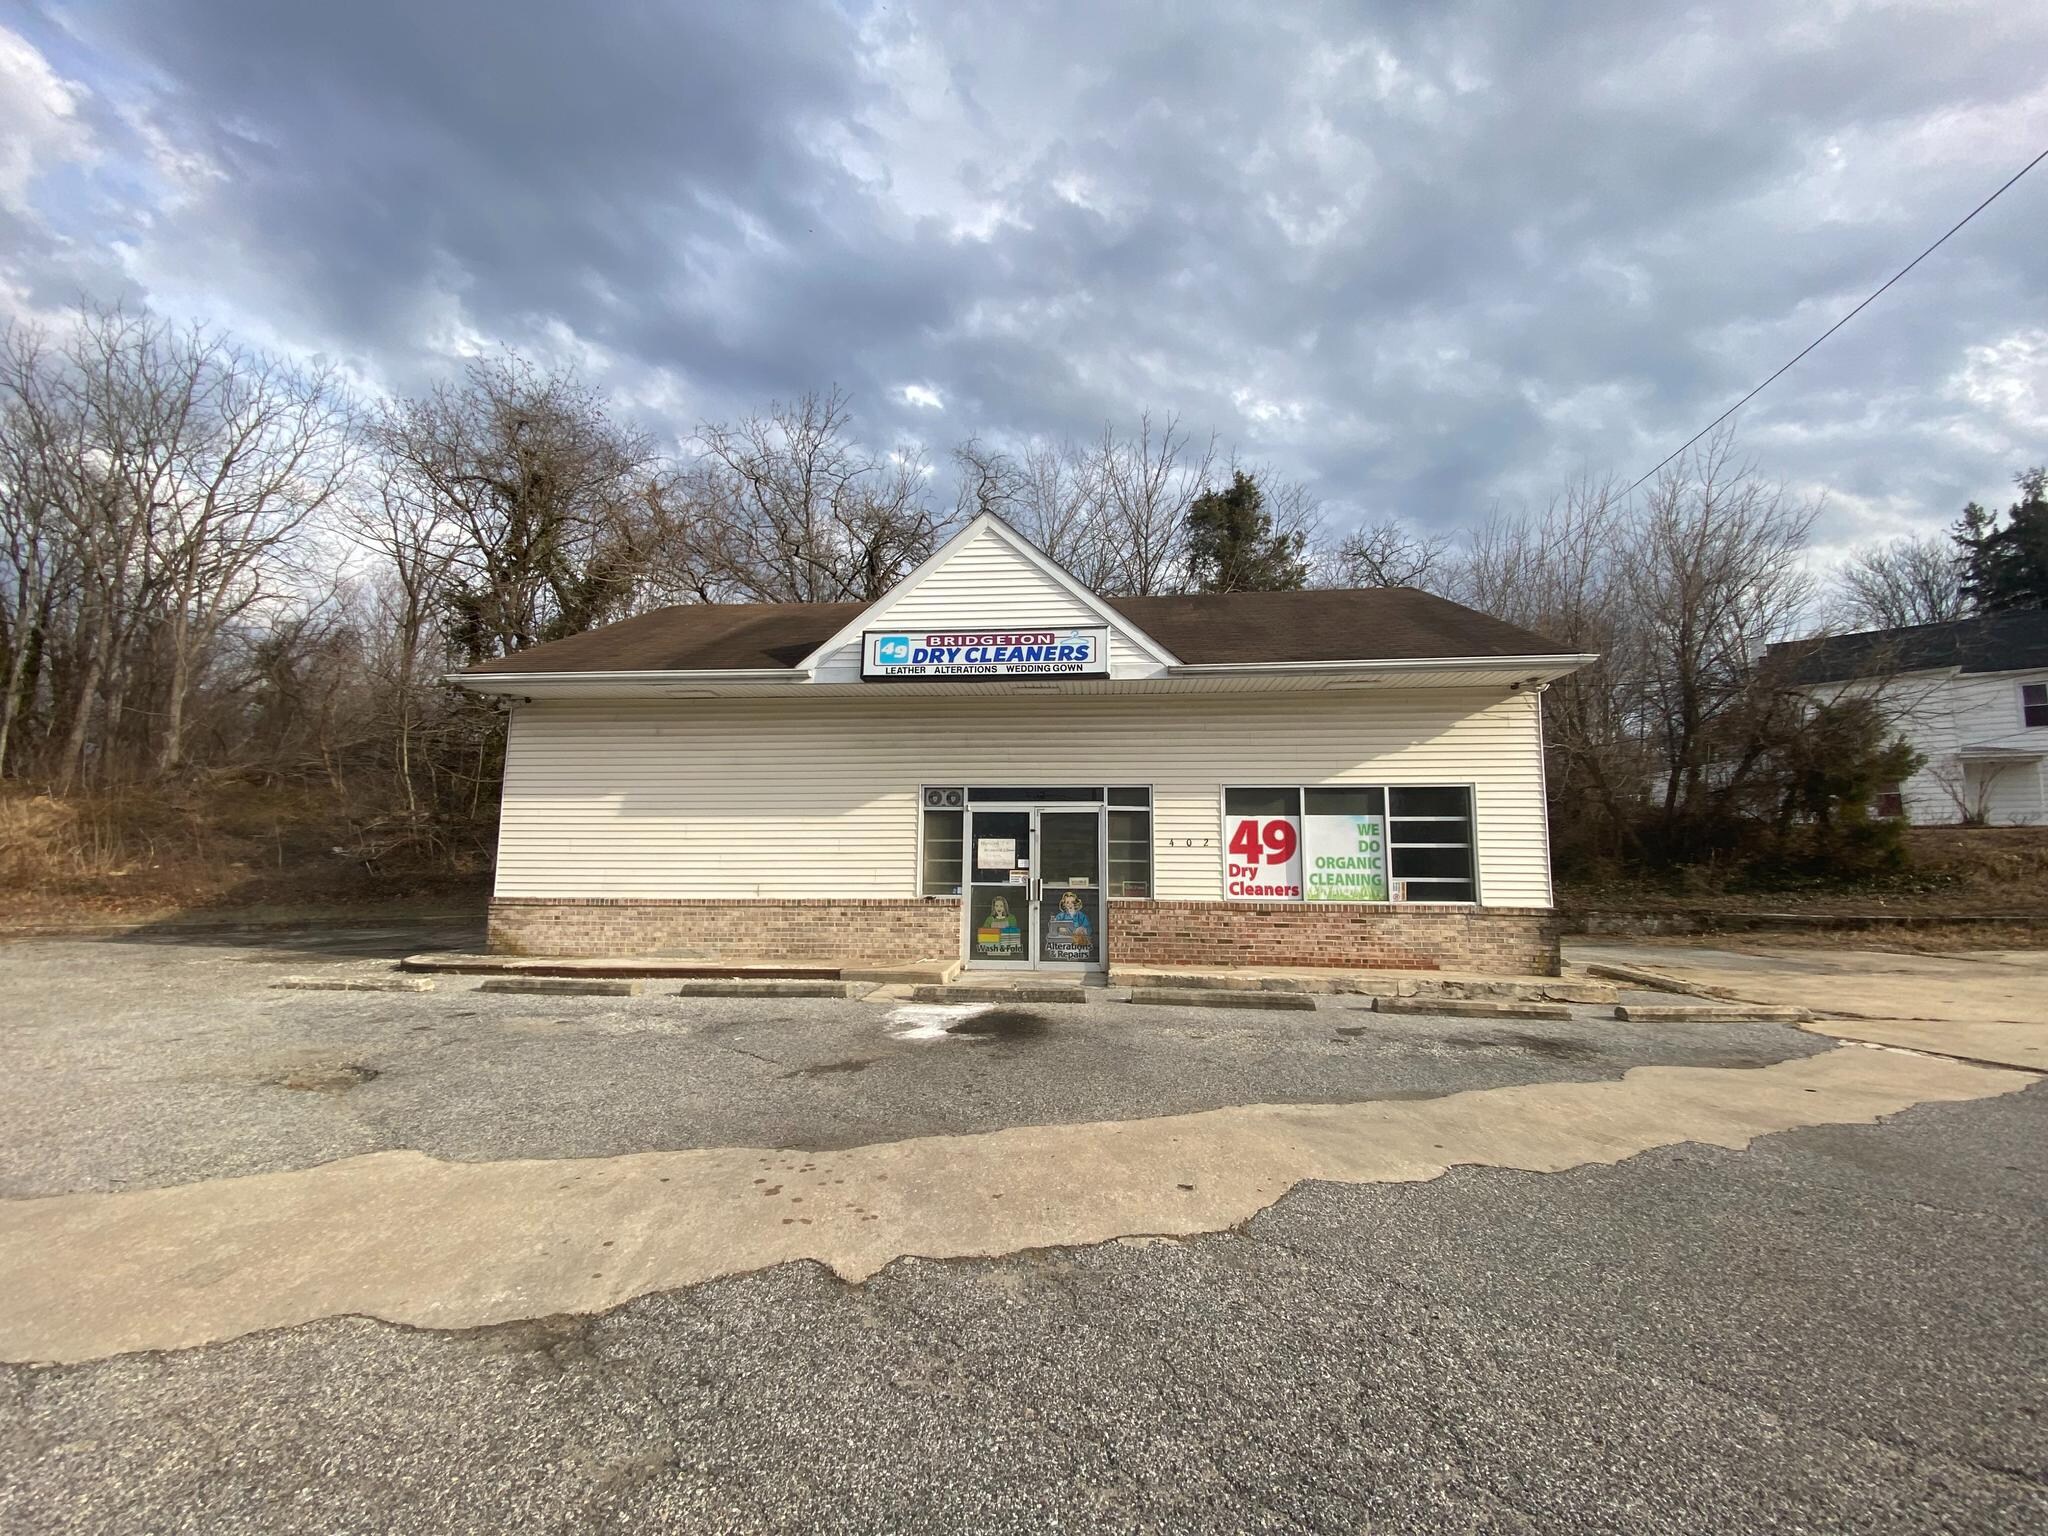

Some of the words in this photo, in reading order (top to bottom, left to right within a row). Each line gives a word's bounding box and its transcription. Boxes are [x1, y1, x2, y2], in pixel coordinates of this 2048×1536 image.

[930, 635, 1051, 646] BRIDGETON
[912, 648, 958, 664] DRY
[965, 645, 1090, 663] CLEANERS
[885, 666, 926, 675] LEATHER
[934, 665, 998, 674] ALTERATIONS
[1006, 664, 1051, 673] WEDDING
[1053, 663, 1083, 672] GOWN
[1357, 823, 1380, 836] WE
[1228, 820, 1297, 865] 49
[1358, 840, 1380, 852] DO
[1315, 857, 1382, 870] ORGANIC
[1228, 864, 1258, 881] Dry
[1309, 873, 1383, 887] CLEANING
[1229, 882, 1300, 897] Cleaners
[977, 944, 998, 953] Wash
[1006, 944, 1023, 953] Fold
[1046, 942, 1093, 952] Alterations
[1058, 950, 1089, 960] Repairs
